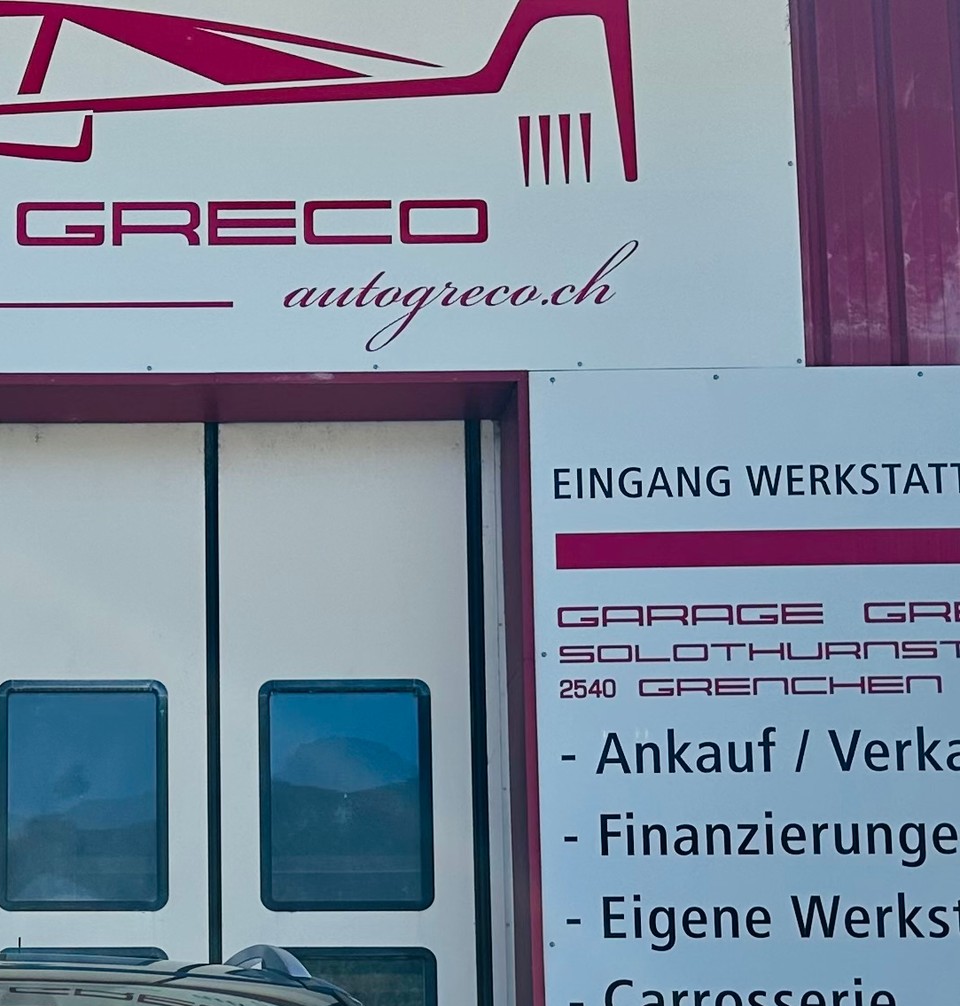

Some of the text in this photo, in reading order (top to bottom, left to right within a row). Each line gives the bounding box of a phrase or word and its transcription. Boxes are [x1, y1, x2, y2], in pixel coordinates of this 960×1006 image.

[16, 198, 489, 247] GRECO
[283, 239, 640, 352] autogreco.ch
[553, 462, 960, 500] EINGANG WERKSTATT
[557, 601, 960, 628] GARAGE GR
[559, 675, 943, 699] 2540 GRENCHEN
[595, 726, 777, 774] Ankauf
[794, 728, 811, 773] /
[827, 725, 960, 773] Verka
[599, 810, 958, 868] Finanzierunge
[602, 894, 772, 952] Eigene
